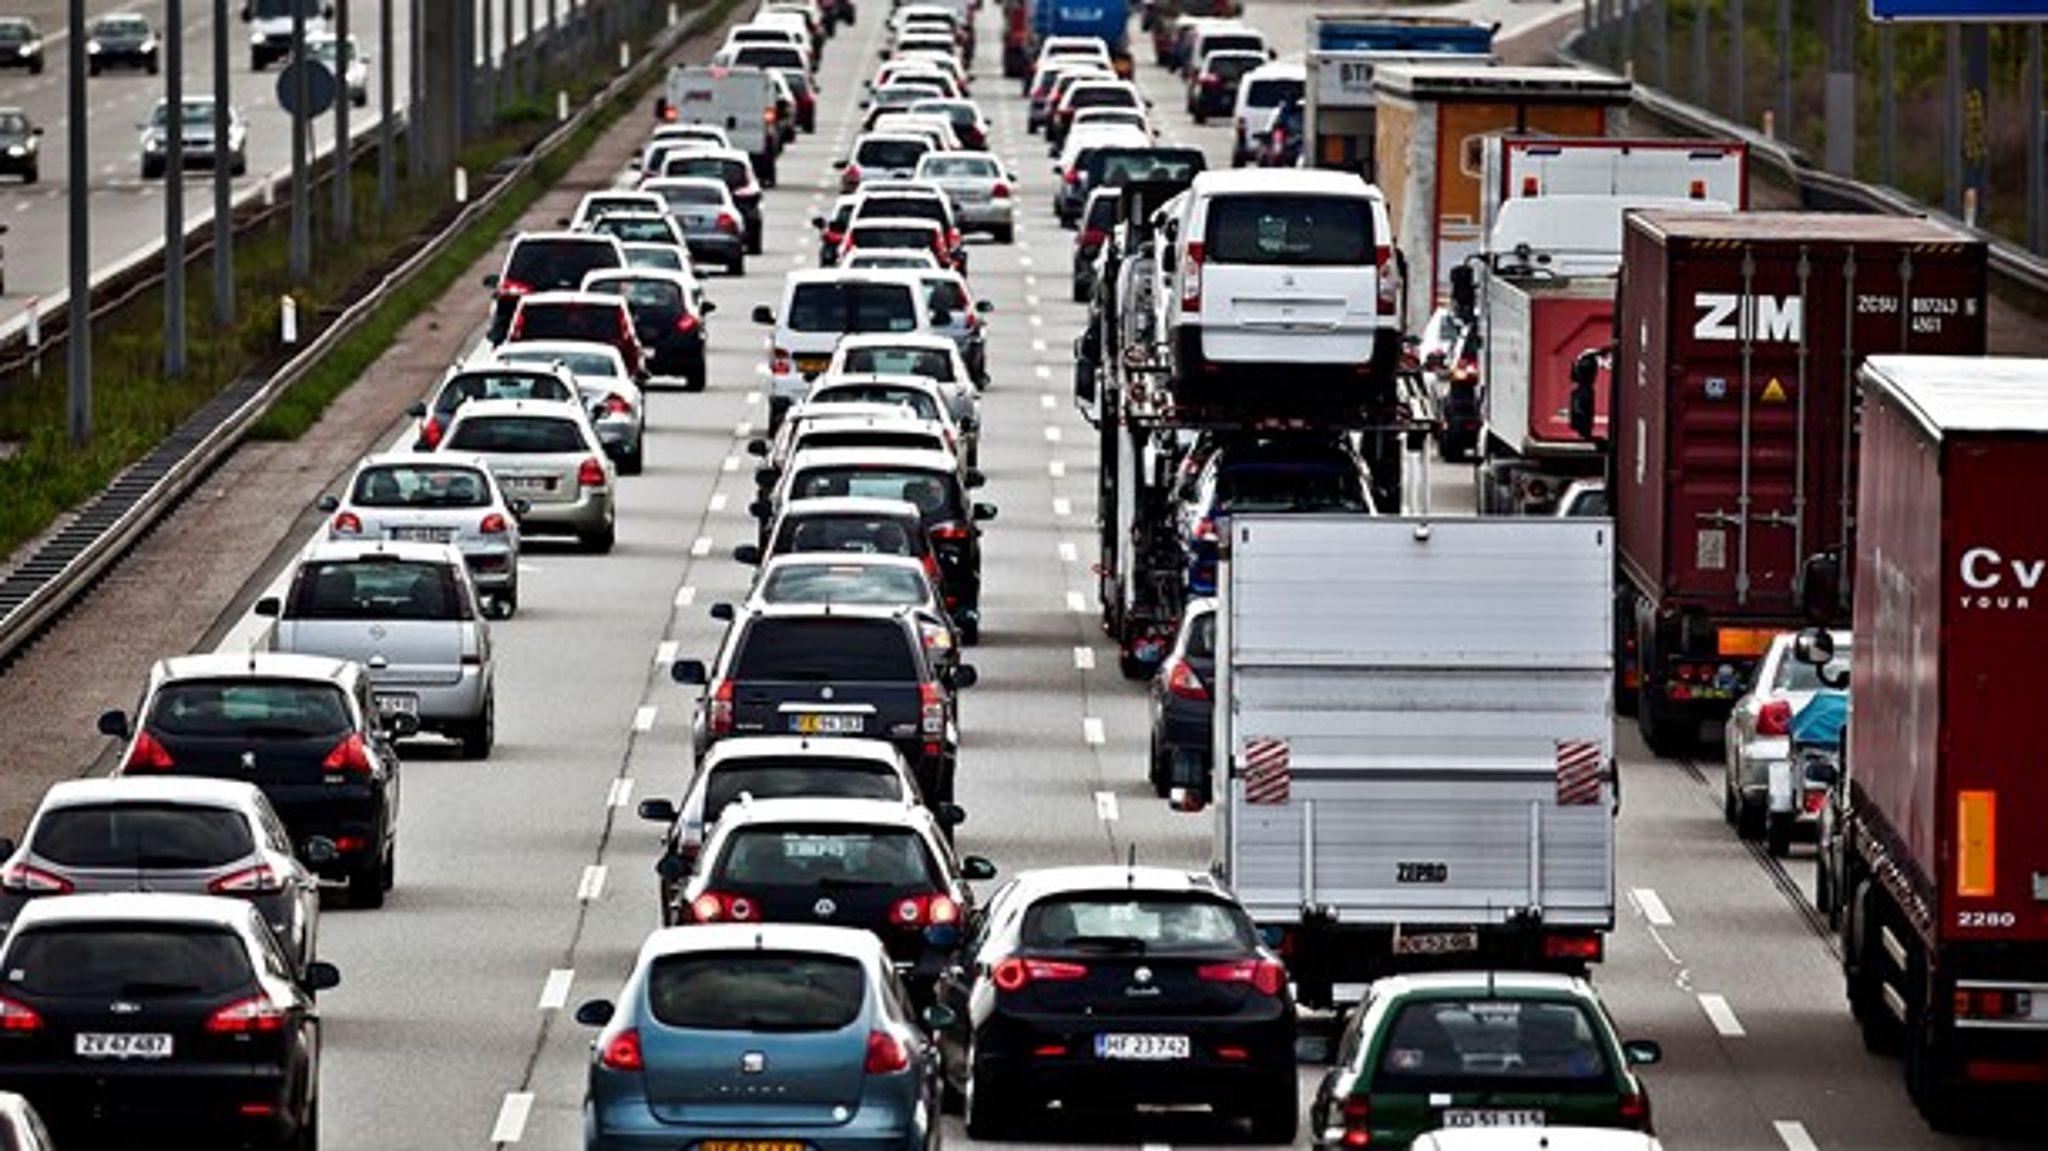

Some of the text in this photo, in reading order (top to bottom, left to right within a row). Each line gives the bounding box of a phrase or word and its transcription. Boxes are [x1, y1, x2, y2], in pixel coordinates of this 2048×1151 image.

[1694, 293, 1802, 341] ZIM
[1961, 546, 2045, 589] Cv
[1961, 595, 2029, 609] YOUR
[1396, 862, 1448, 883] ZEPRO
[1957, 911, 2016, 927] 2280
